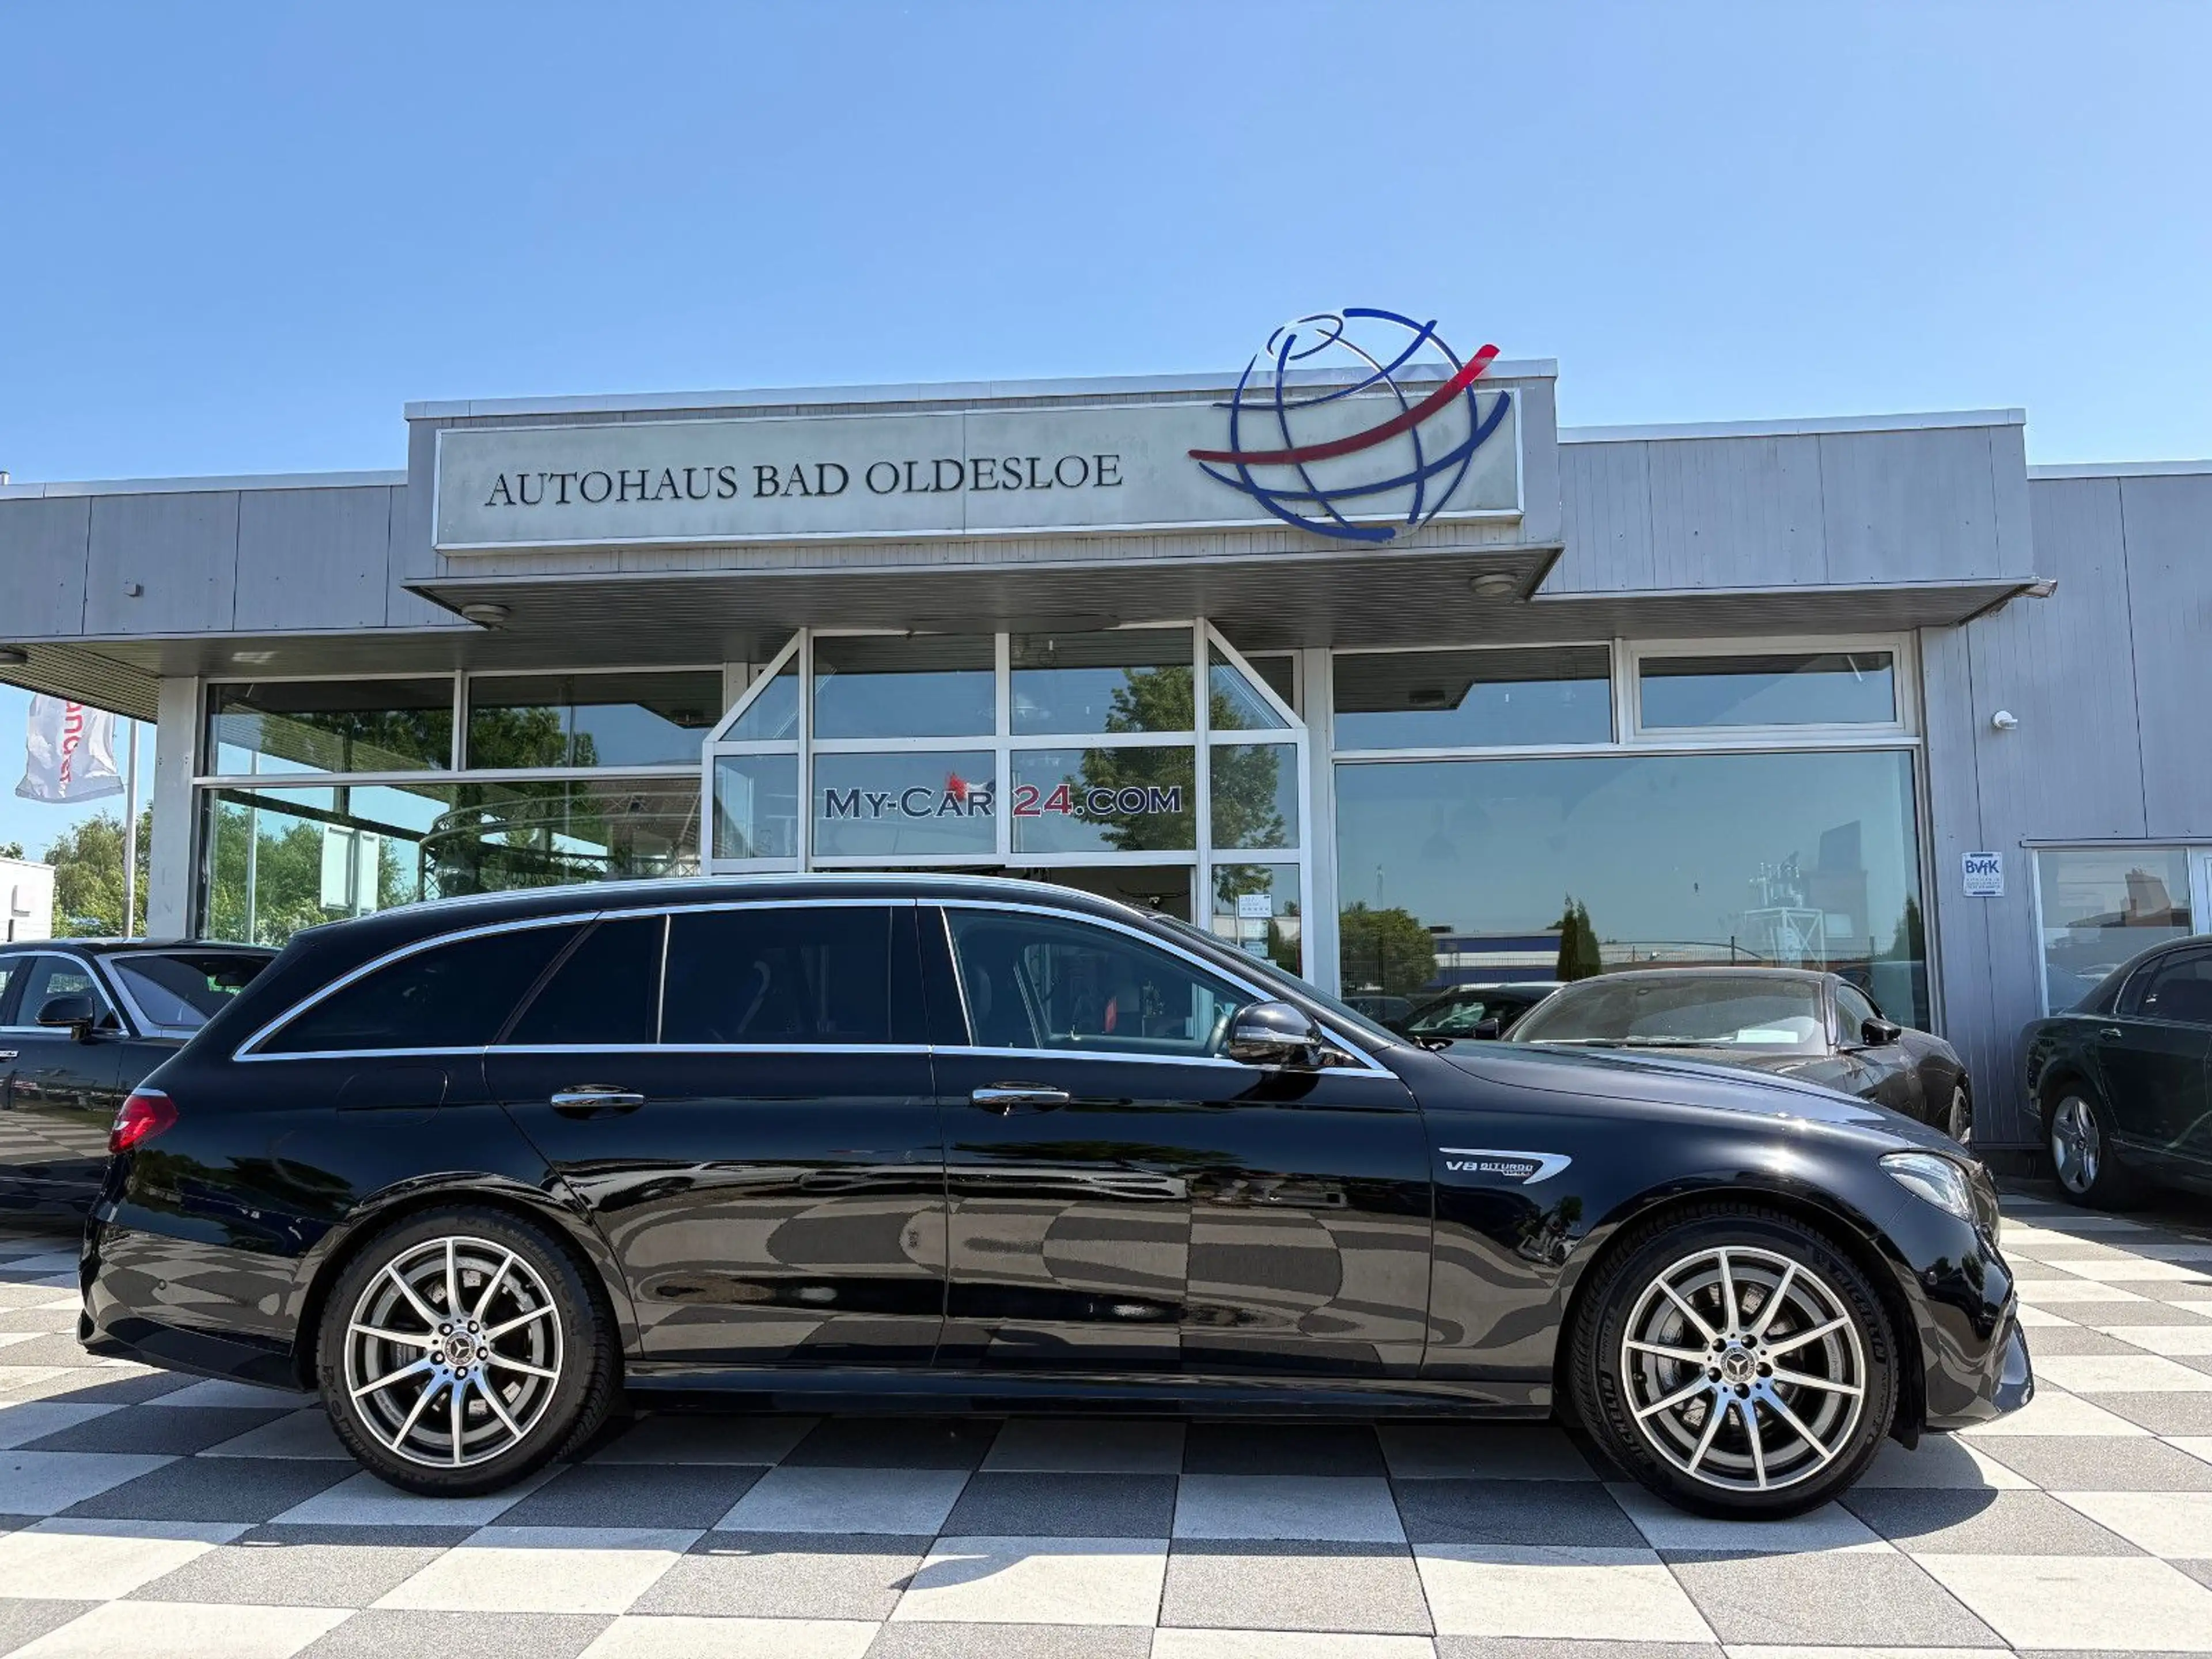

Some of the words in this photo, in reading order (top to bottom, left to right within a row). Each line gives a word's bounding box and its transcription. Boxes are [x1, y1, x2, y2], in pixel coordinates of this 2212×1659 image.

[485, 465, 738, 506] AUTOHAUS
[753, 463, 850, 498] BAD
[865, 454, 1123, 495] OLDESLOE
[1446, 1161, 1478, 1171] V8
